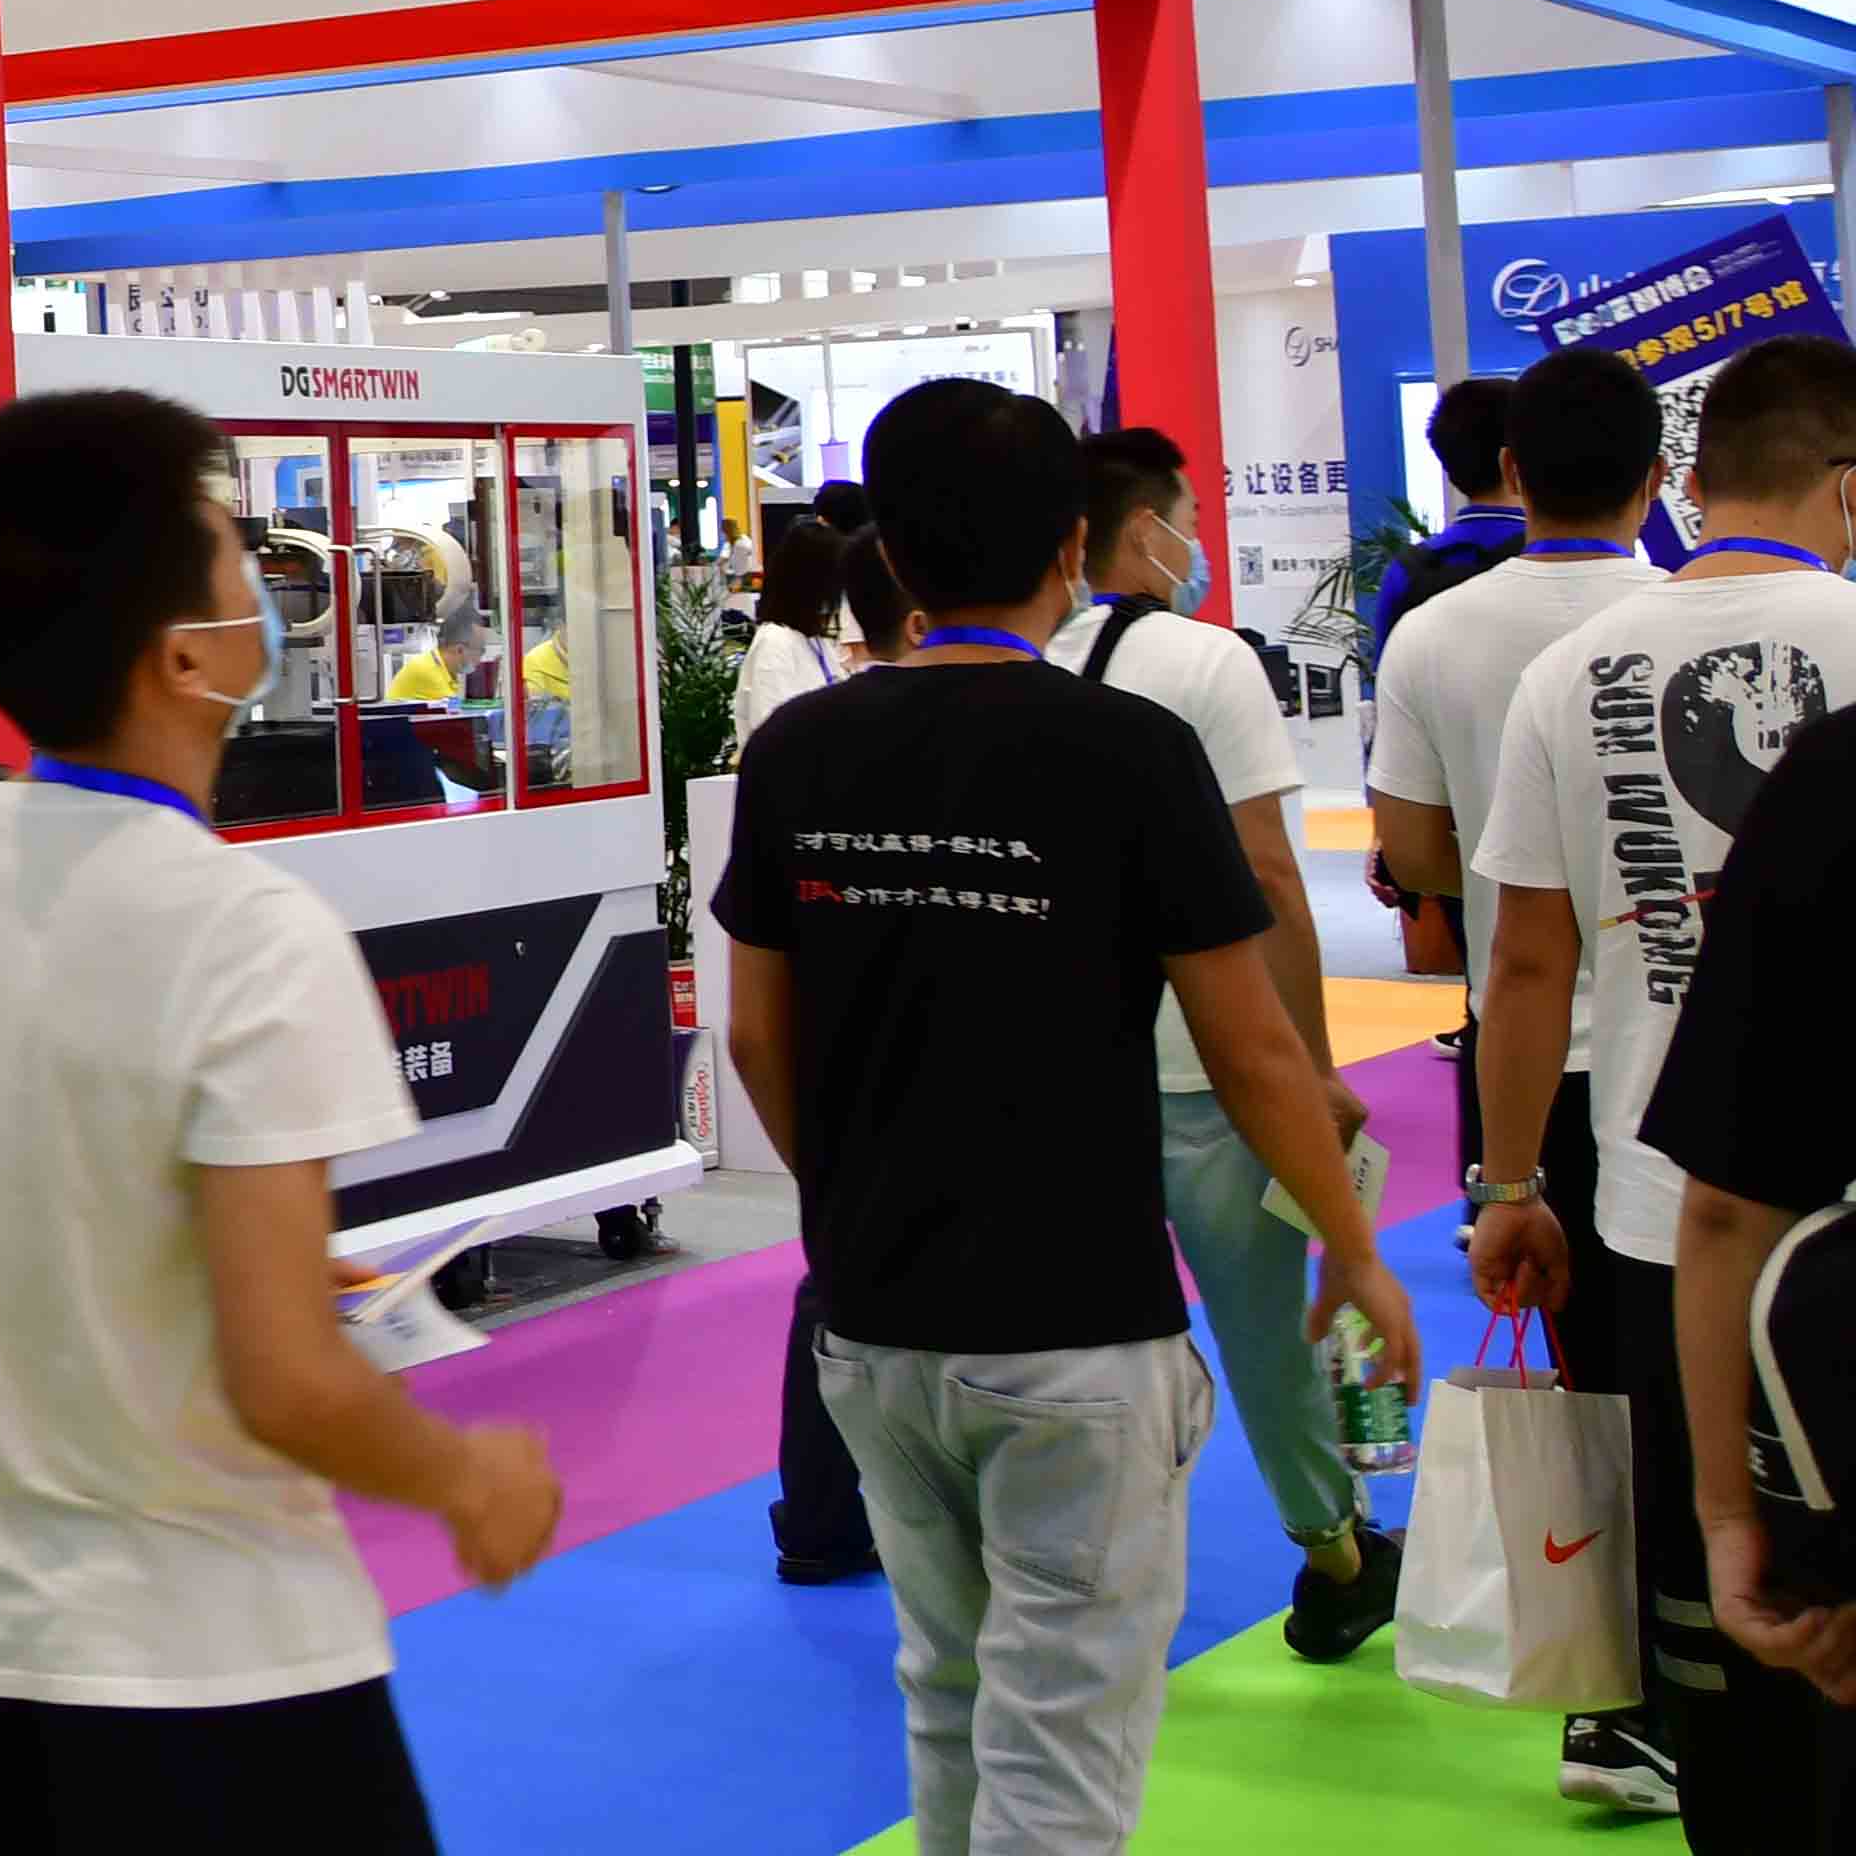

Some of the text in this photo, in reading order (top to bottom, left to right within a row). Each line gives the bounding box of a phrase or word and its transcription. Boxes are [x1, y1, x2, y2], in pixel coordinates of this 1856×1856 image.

[280, 365, 420, 401] DGSMARTWIN
[1588, 652, 1656, 758] SUN
[394, 1041, 453, 1082] 装备
